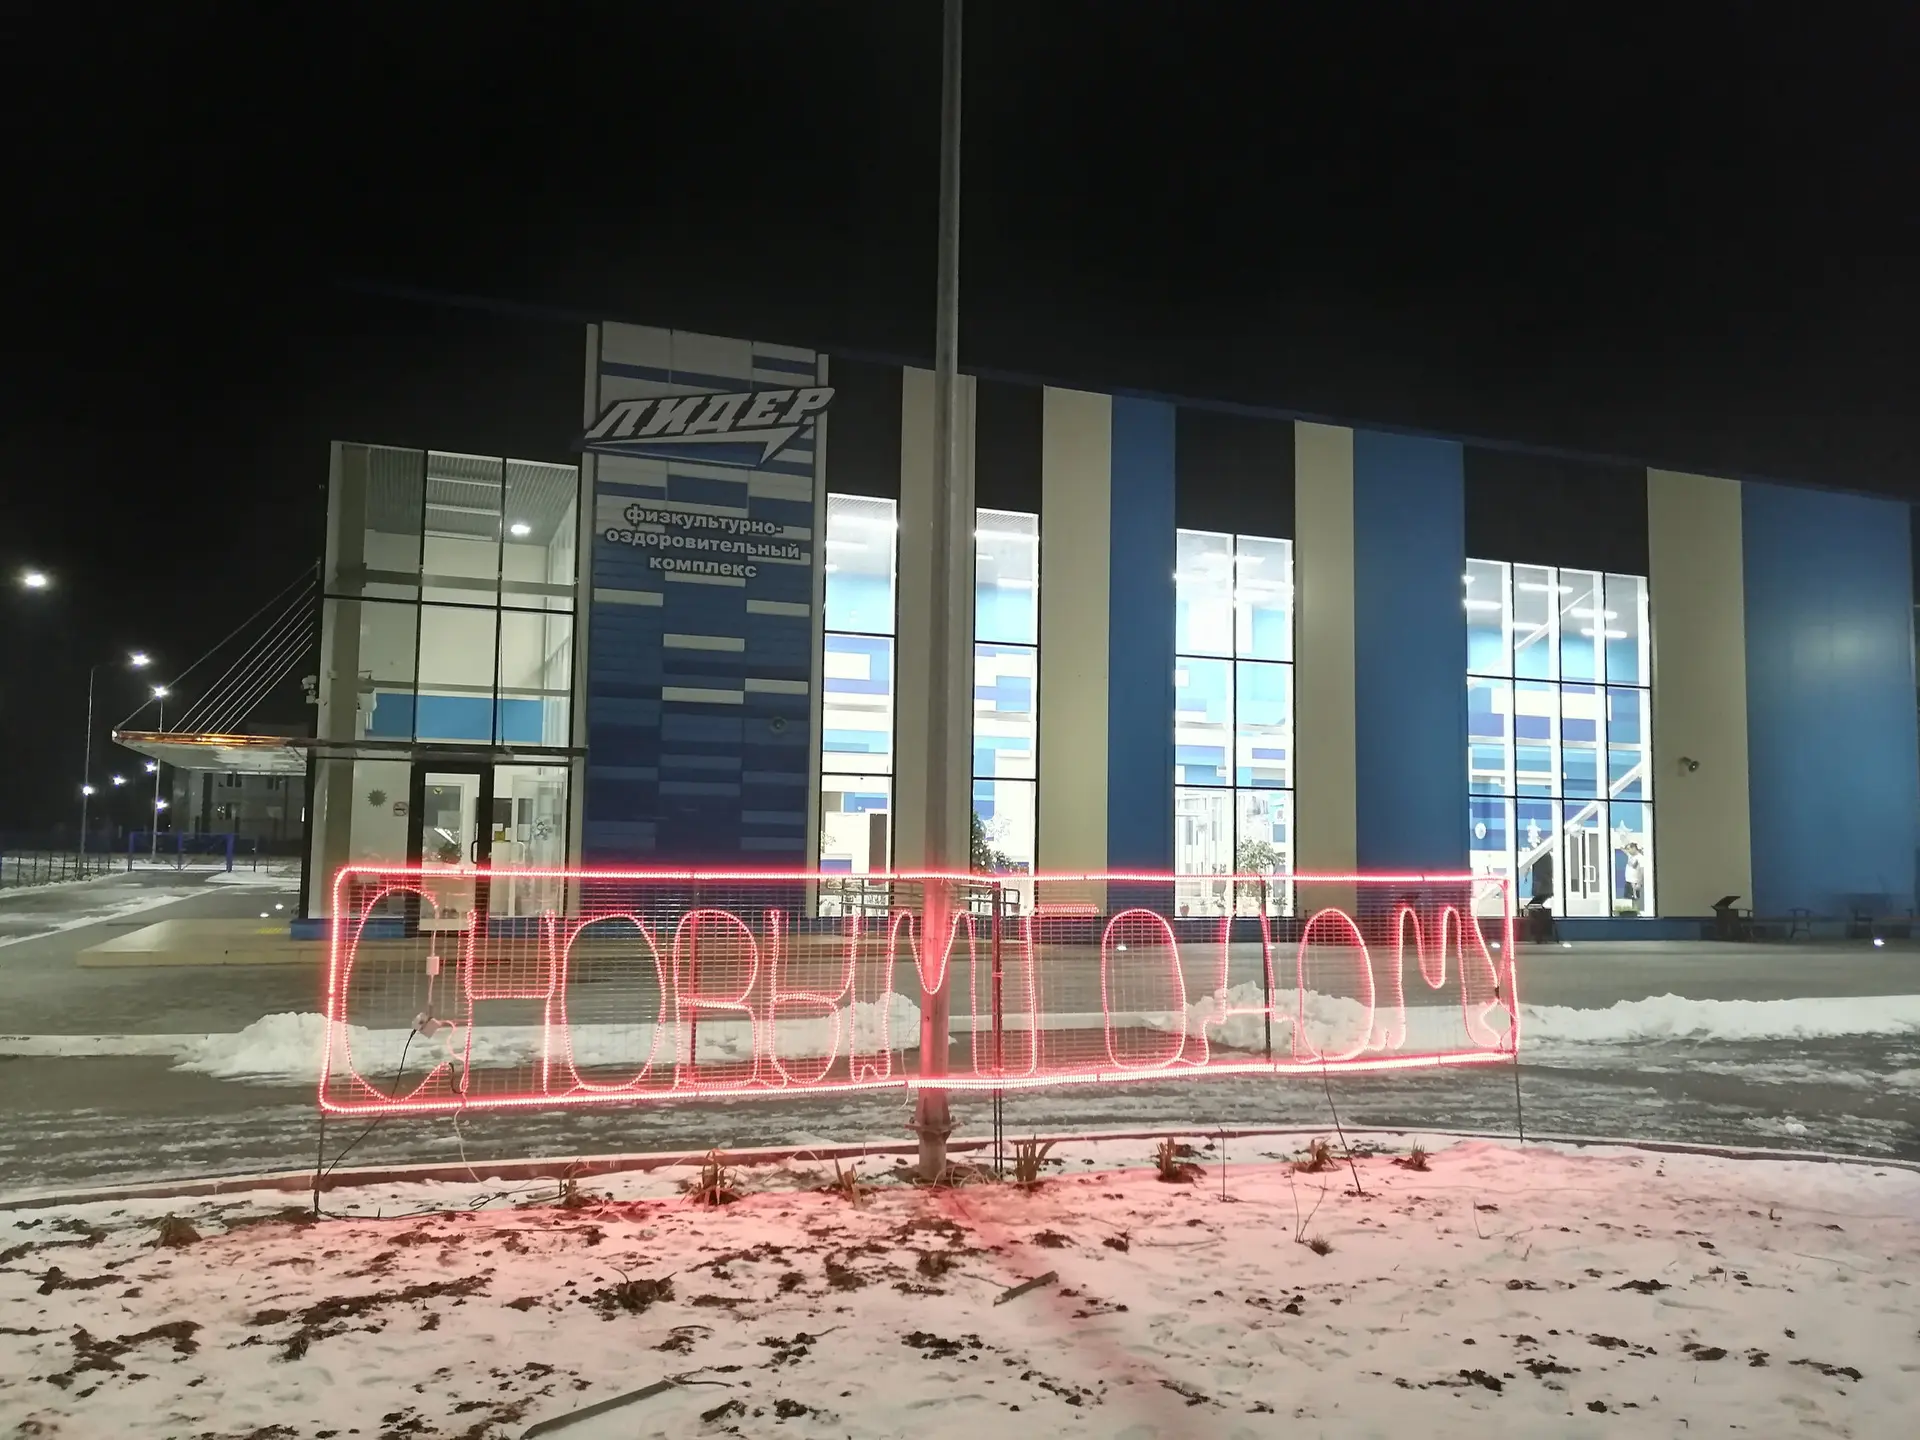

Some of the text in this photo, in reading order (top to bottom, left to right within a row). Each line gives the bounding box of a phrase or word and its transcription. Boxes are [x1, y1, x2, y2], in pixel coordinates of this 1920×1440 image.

[584, 387, 836, 439] ЛИДЕР
[625, 504, 784, 535] физкультурно-
[605, 528, 800, 559] оздоровительный
[649, 556, 757, 578] комплекс
